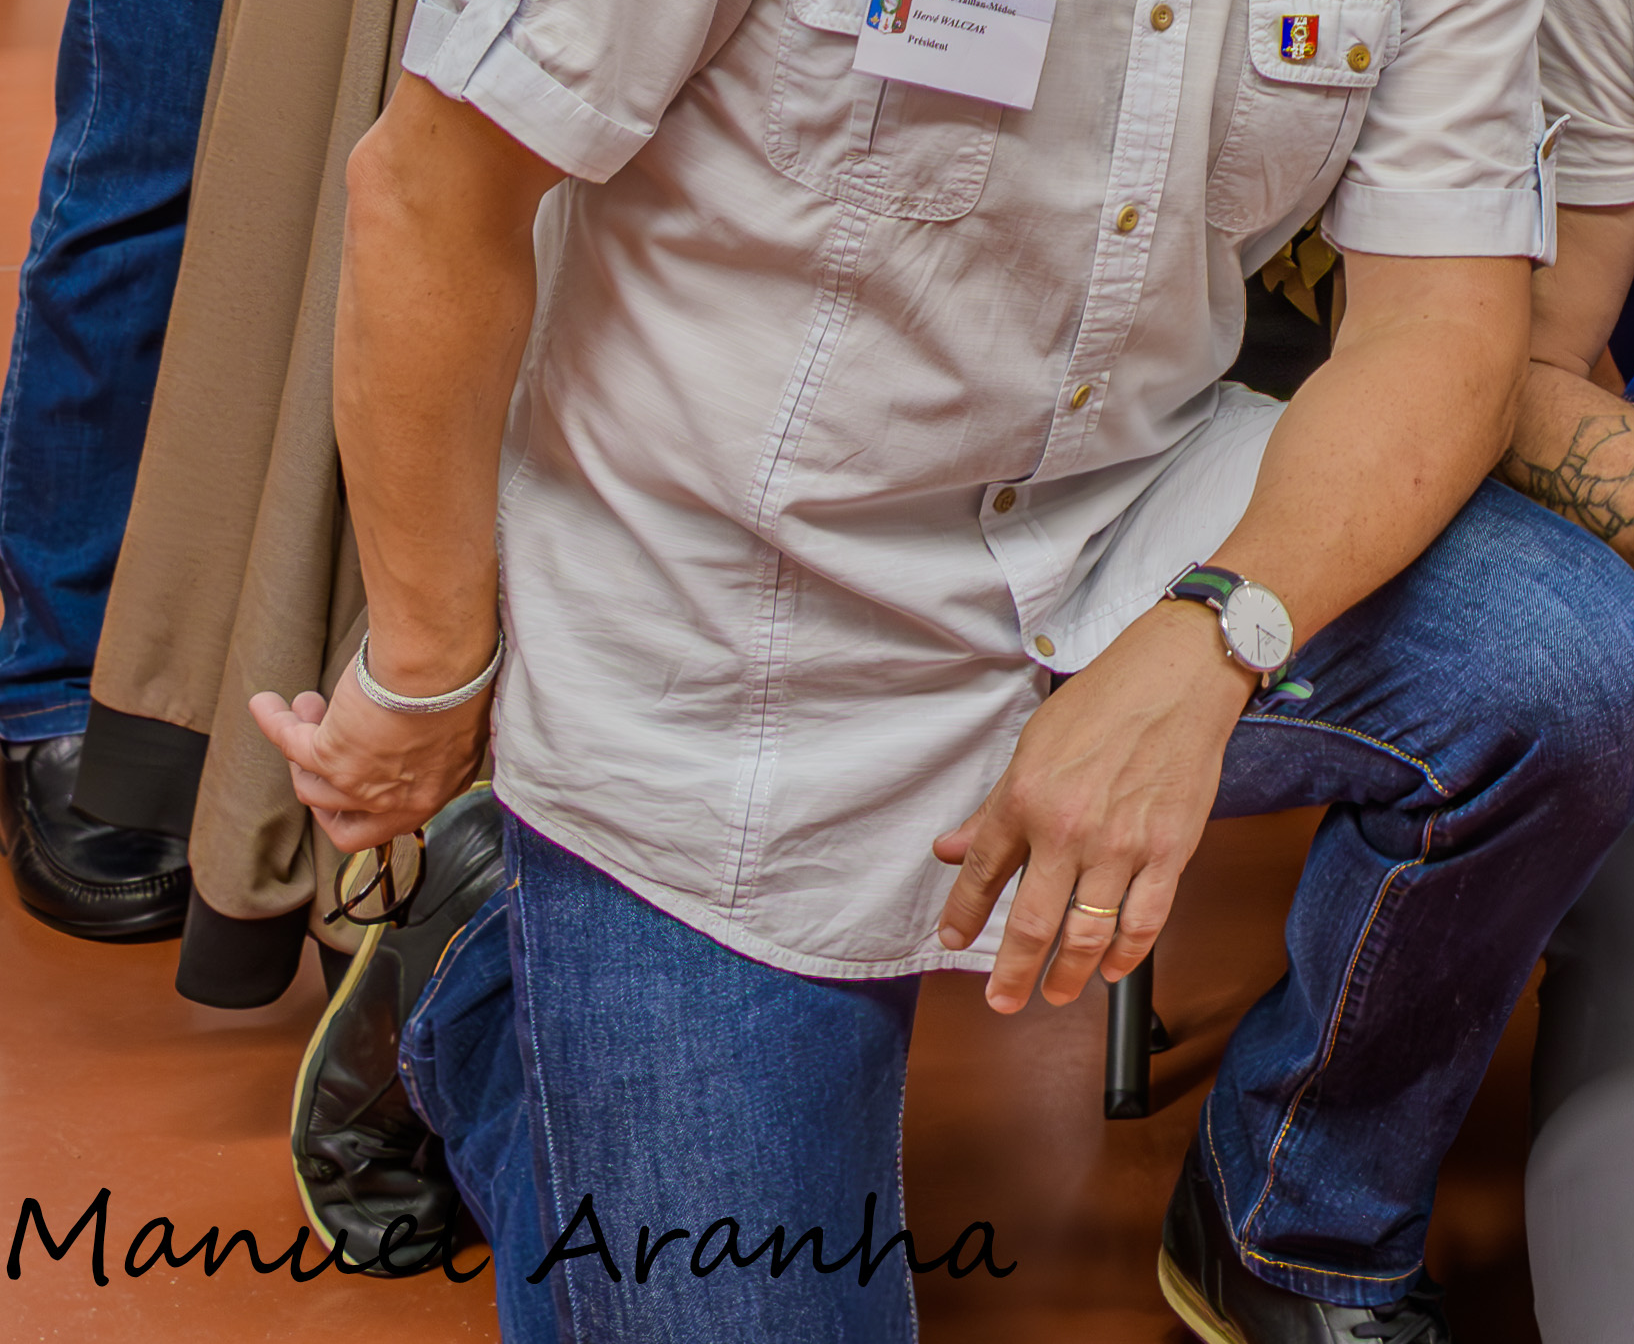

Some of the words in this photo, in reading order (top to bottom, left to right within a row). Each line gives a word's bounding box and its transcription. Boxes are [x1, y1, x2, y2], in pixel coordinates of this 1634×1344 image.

[912, 9, 940, 23] Hervé
[940, 15, 988, 35] WALCZAK
[908, 34, 949, 51] Président
